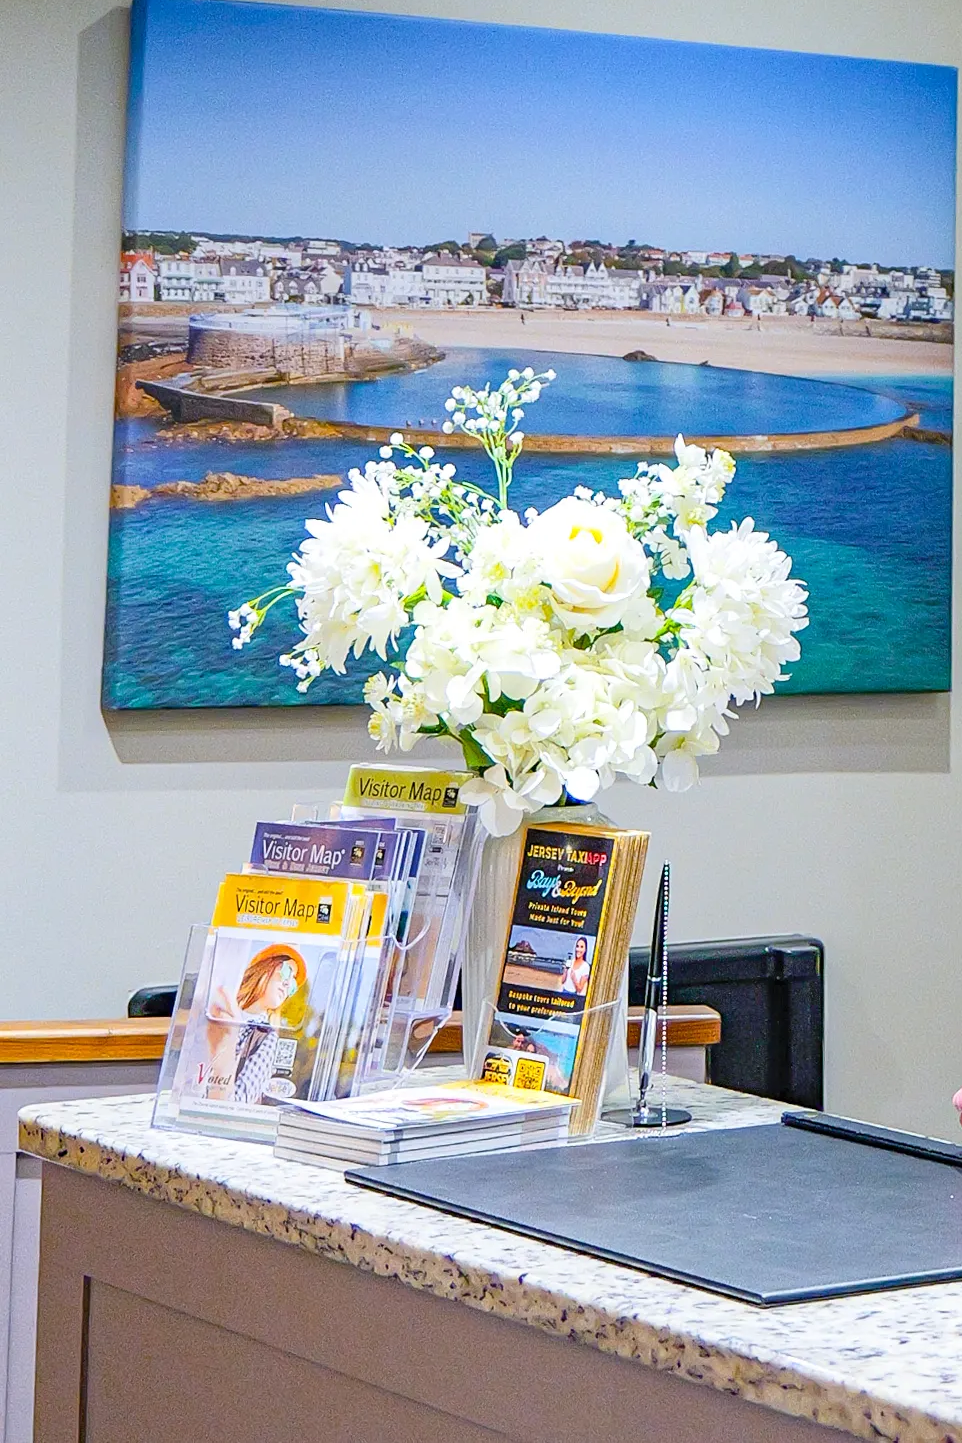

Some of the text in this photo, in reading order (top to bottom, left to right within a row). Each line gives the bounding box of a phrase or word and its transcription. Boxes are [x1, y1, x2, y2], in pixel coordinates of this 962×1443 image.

[359, 777, 406, 799] Visitor
[408, 781, 442, 805] Map
[262, 839, 308, 862] Visitor
[309, 844, 343, 869] Map
[527, 844, 565, 861] JERSEY
[235, 893, 281, 915] Visitor
[283, 898, 316, 922] Map
[197, 1059, 232, 1086] Voted
